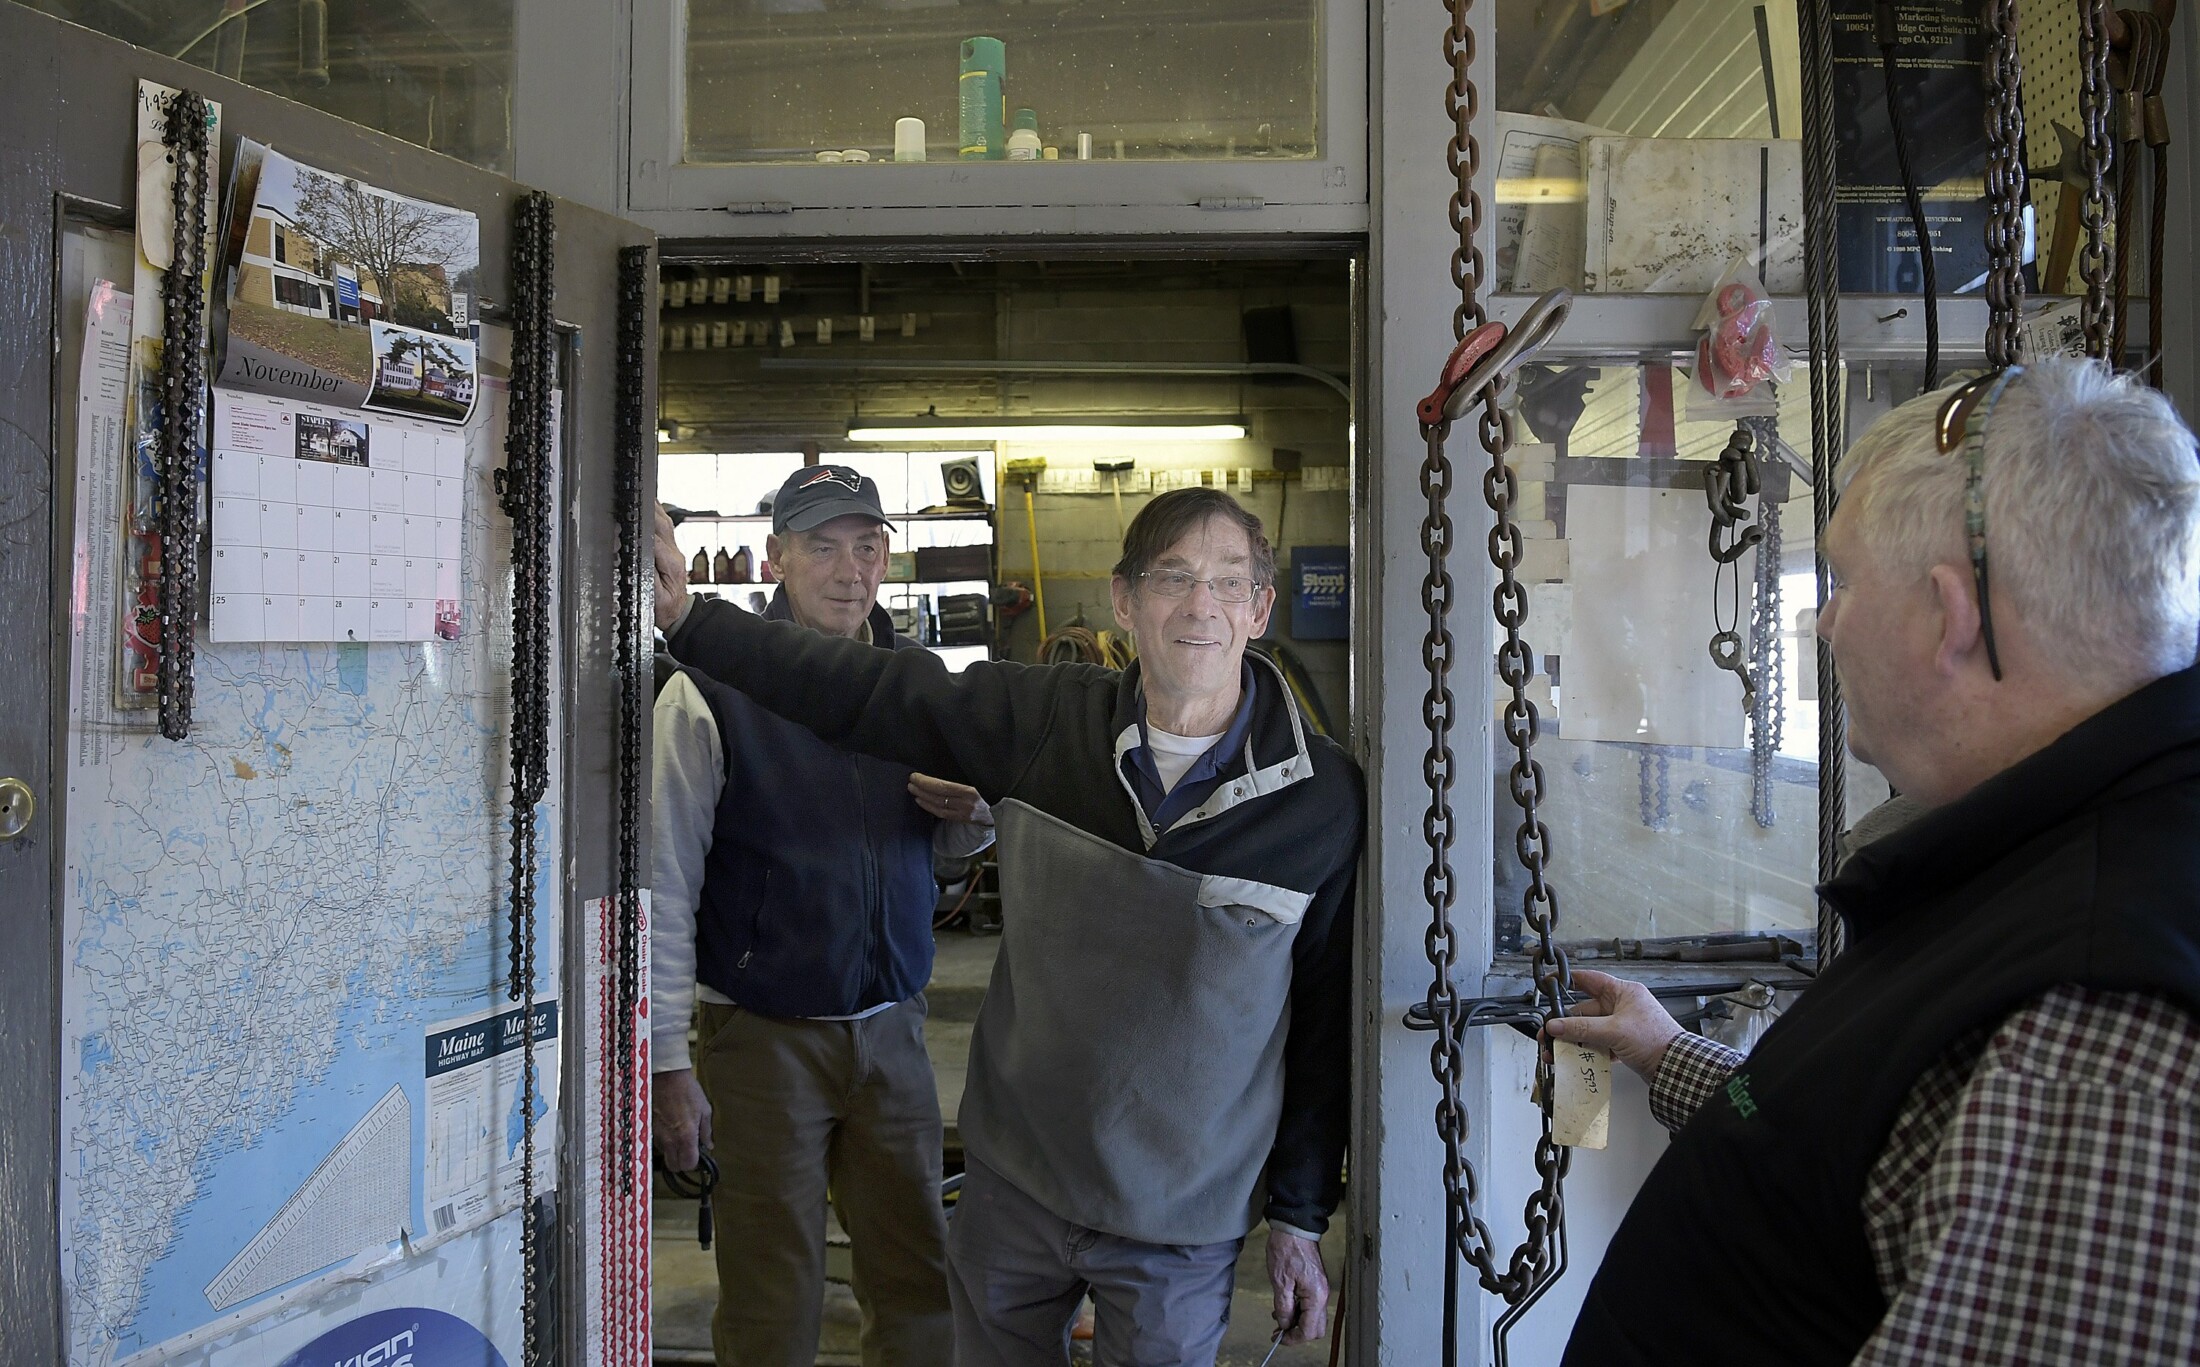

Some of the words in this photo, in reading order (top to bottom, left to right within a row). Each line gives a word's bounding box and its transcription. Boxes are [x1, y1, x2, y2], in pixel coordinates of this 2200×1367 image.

[1899, 13, 1940, 24] Marketing
[1941, 15, 1973, 24] Services,
[1897, 24, 1917, 33] idge
[1918, 25, 1941, 33] Court
[1913, 36, 1929, 45] CA,
[1930, 36, 1952, 44] 92121
[454, 312, 466, 324] 25
[236, 356, 342, 392] November
[301, 415, 331, 425] STAPLES
[1303, 574, 1345, 586] Stant
[502, 1013, 547, 1037] Mane
[503, 1033, 524, 1046] HIGHW
[532, 1027, 546, 1036] MAP
[438, 1032, 485, 1058] Maine
[438, 1051, 470, 1067] HIGHWAY
[470, 1047, 485, 1057] MAP
